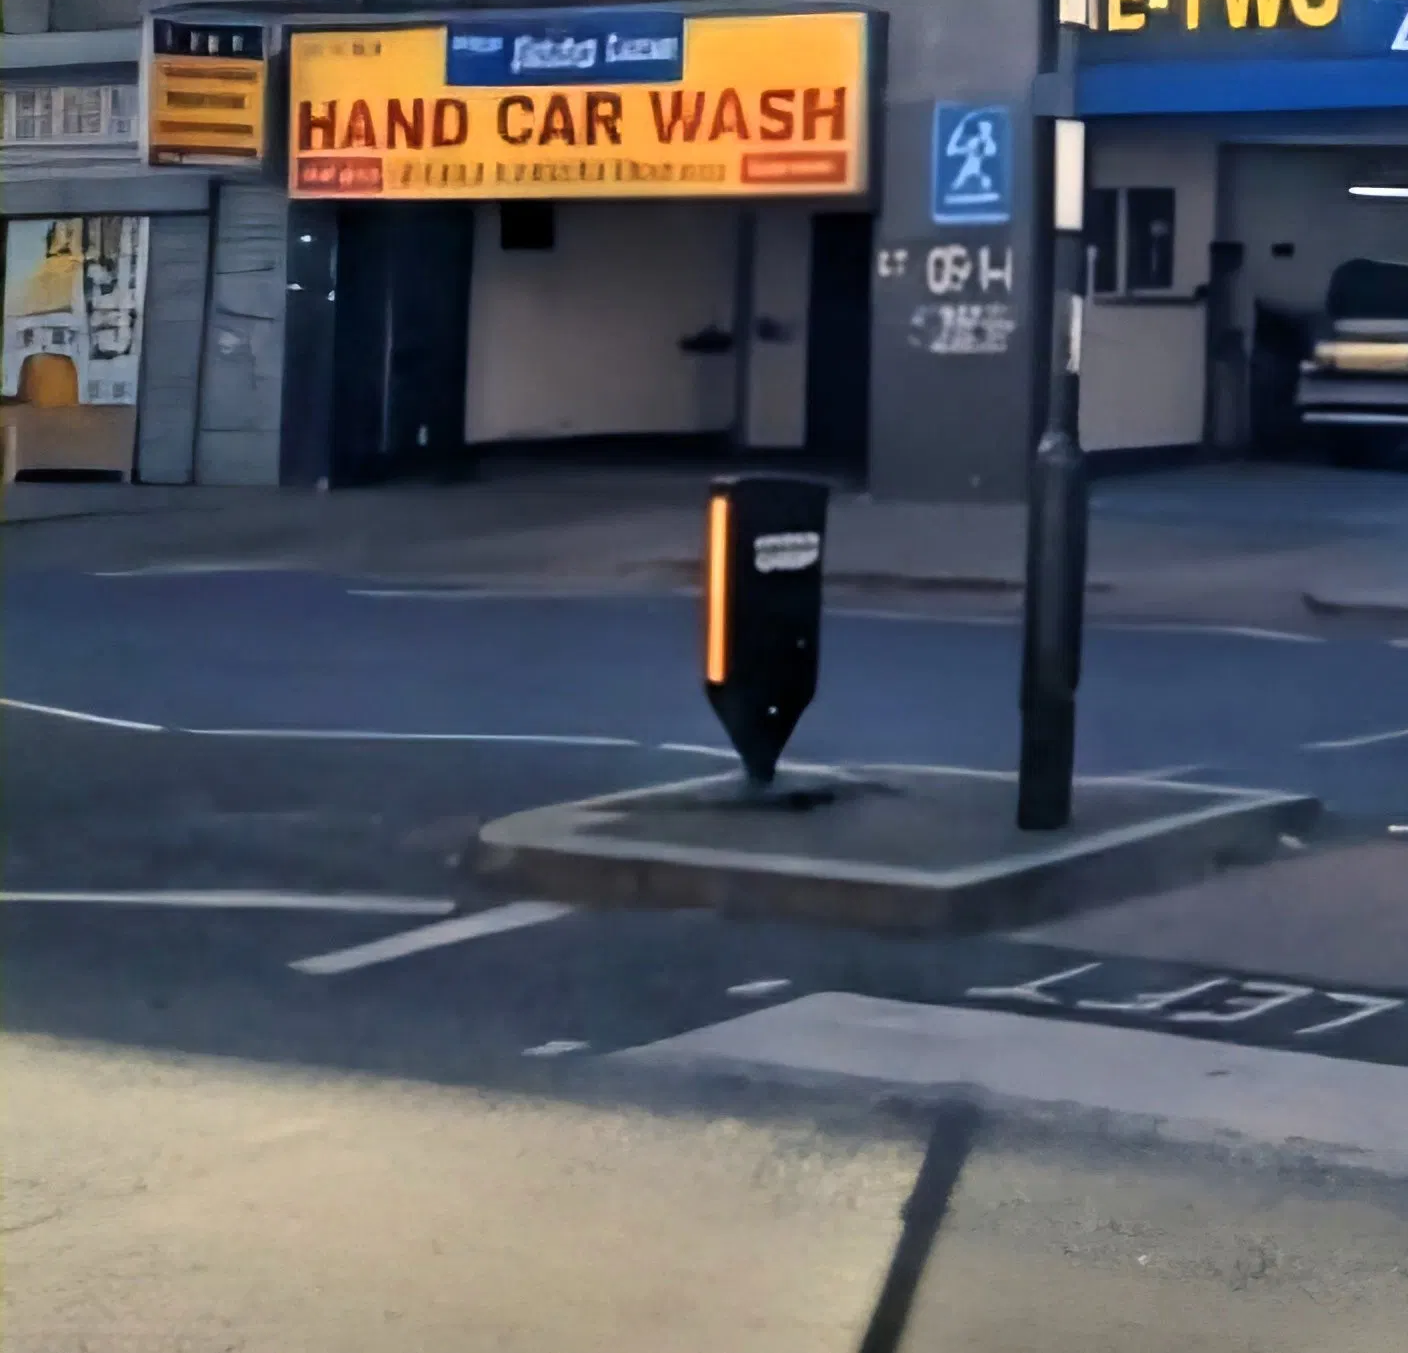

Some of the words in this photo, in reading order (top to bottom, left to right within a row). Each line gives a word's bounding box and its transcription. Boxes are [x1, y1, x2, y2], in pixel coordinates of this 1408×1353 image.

[298, 98, 469, 150] HAND
[496, 91, 622, 146] CAR
[649, 86, 847, 144] WASH
[964, 961, 1406, 1034] LEFT
